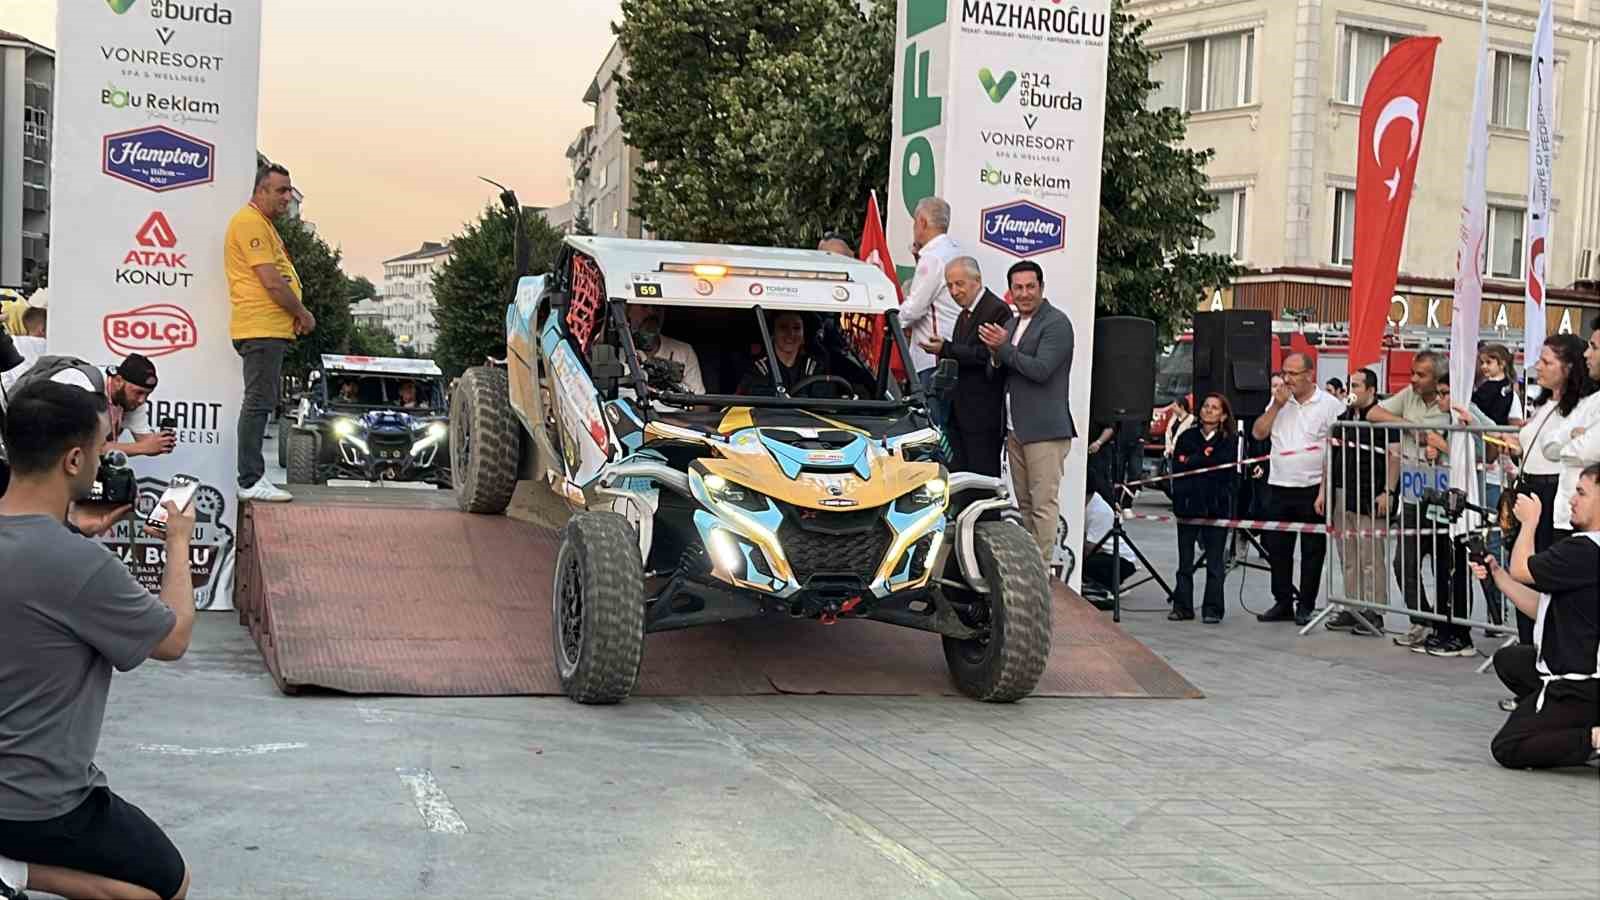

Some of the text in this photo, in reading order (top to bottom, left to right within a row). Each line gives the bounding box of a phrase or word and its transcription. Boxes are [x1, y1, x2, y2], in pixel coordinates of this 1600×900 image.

[165, 0, 232, 25] burda
[962, 0, 1104, 37] MAZHAROĞLU
[100, 46, 223, 71] VONRESORT
[121, 69, 139, 78] SPA
[154, 71, 206, 83] WELLNESS
[1032, 72, 1050, 89] 14
[1020, 72, 1030, 106] esas
[1031, 88, 1082, 111] burda
[101, 88, 219, 115] Bolu Reklam
[981, 130, 1074, 152] VONRESORT
[109, 142, 208, 168] Hampton
[980, 169, 1070, 189] Bolu Reklam
[986, 214, 1061, 237] Hampton
[123, 250, 187, 268] ATAK
[116, 269, 194, 287] KONUT
[640, 285, 657, 295] 59
